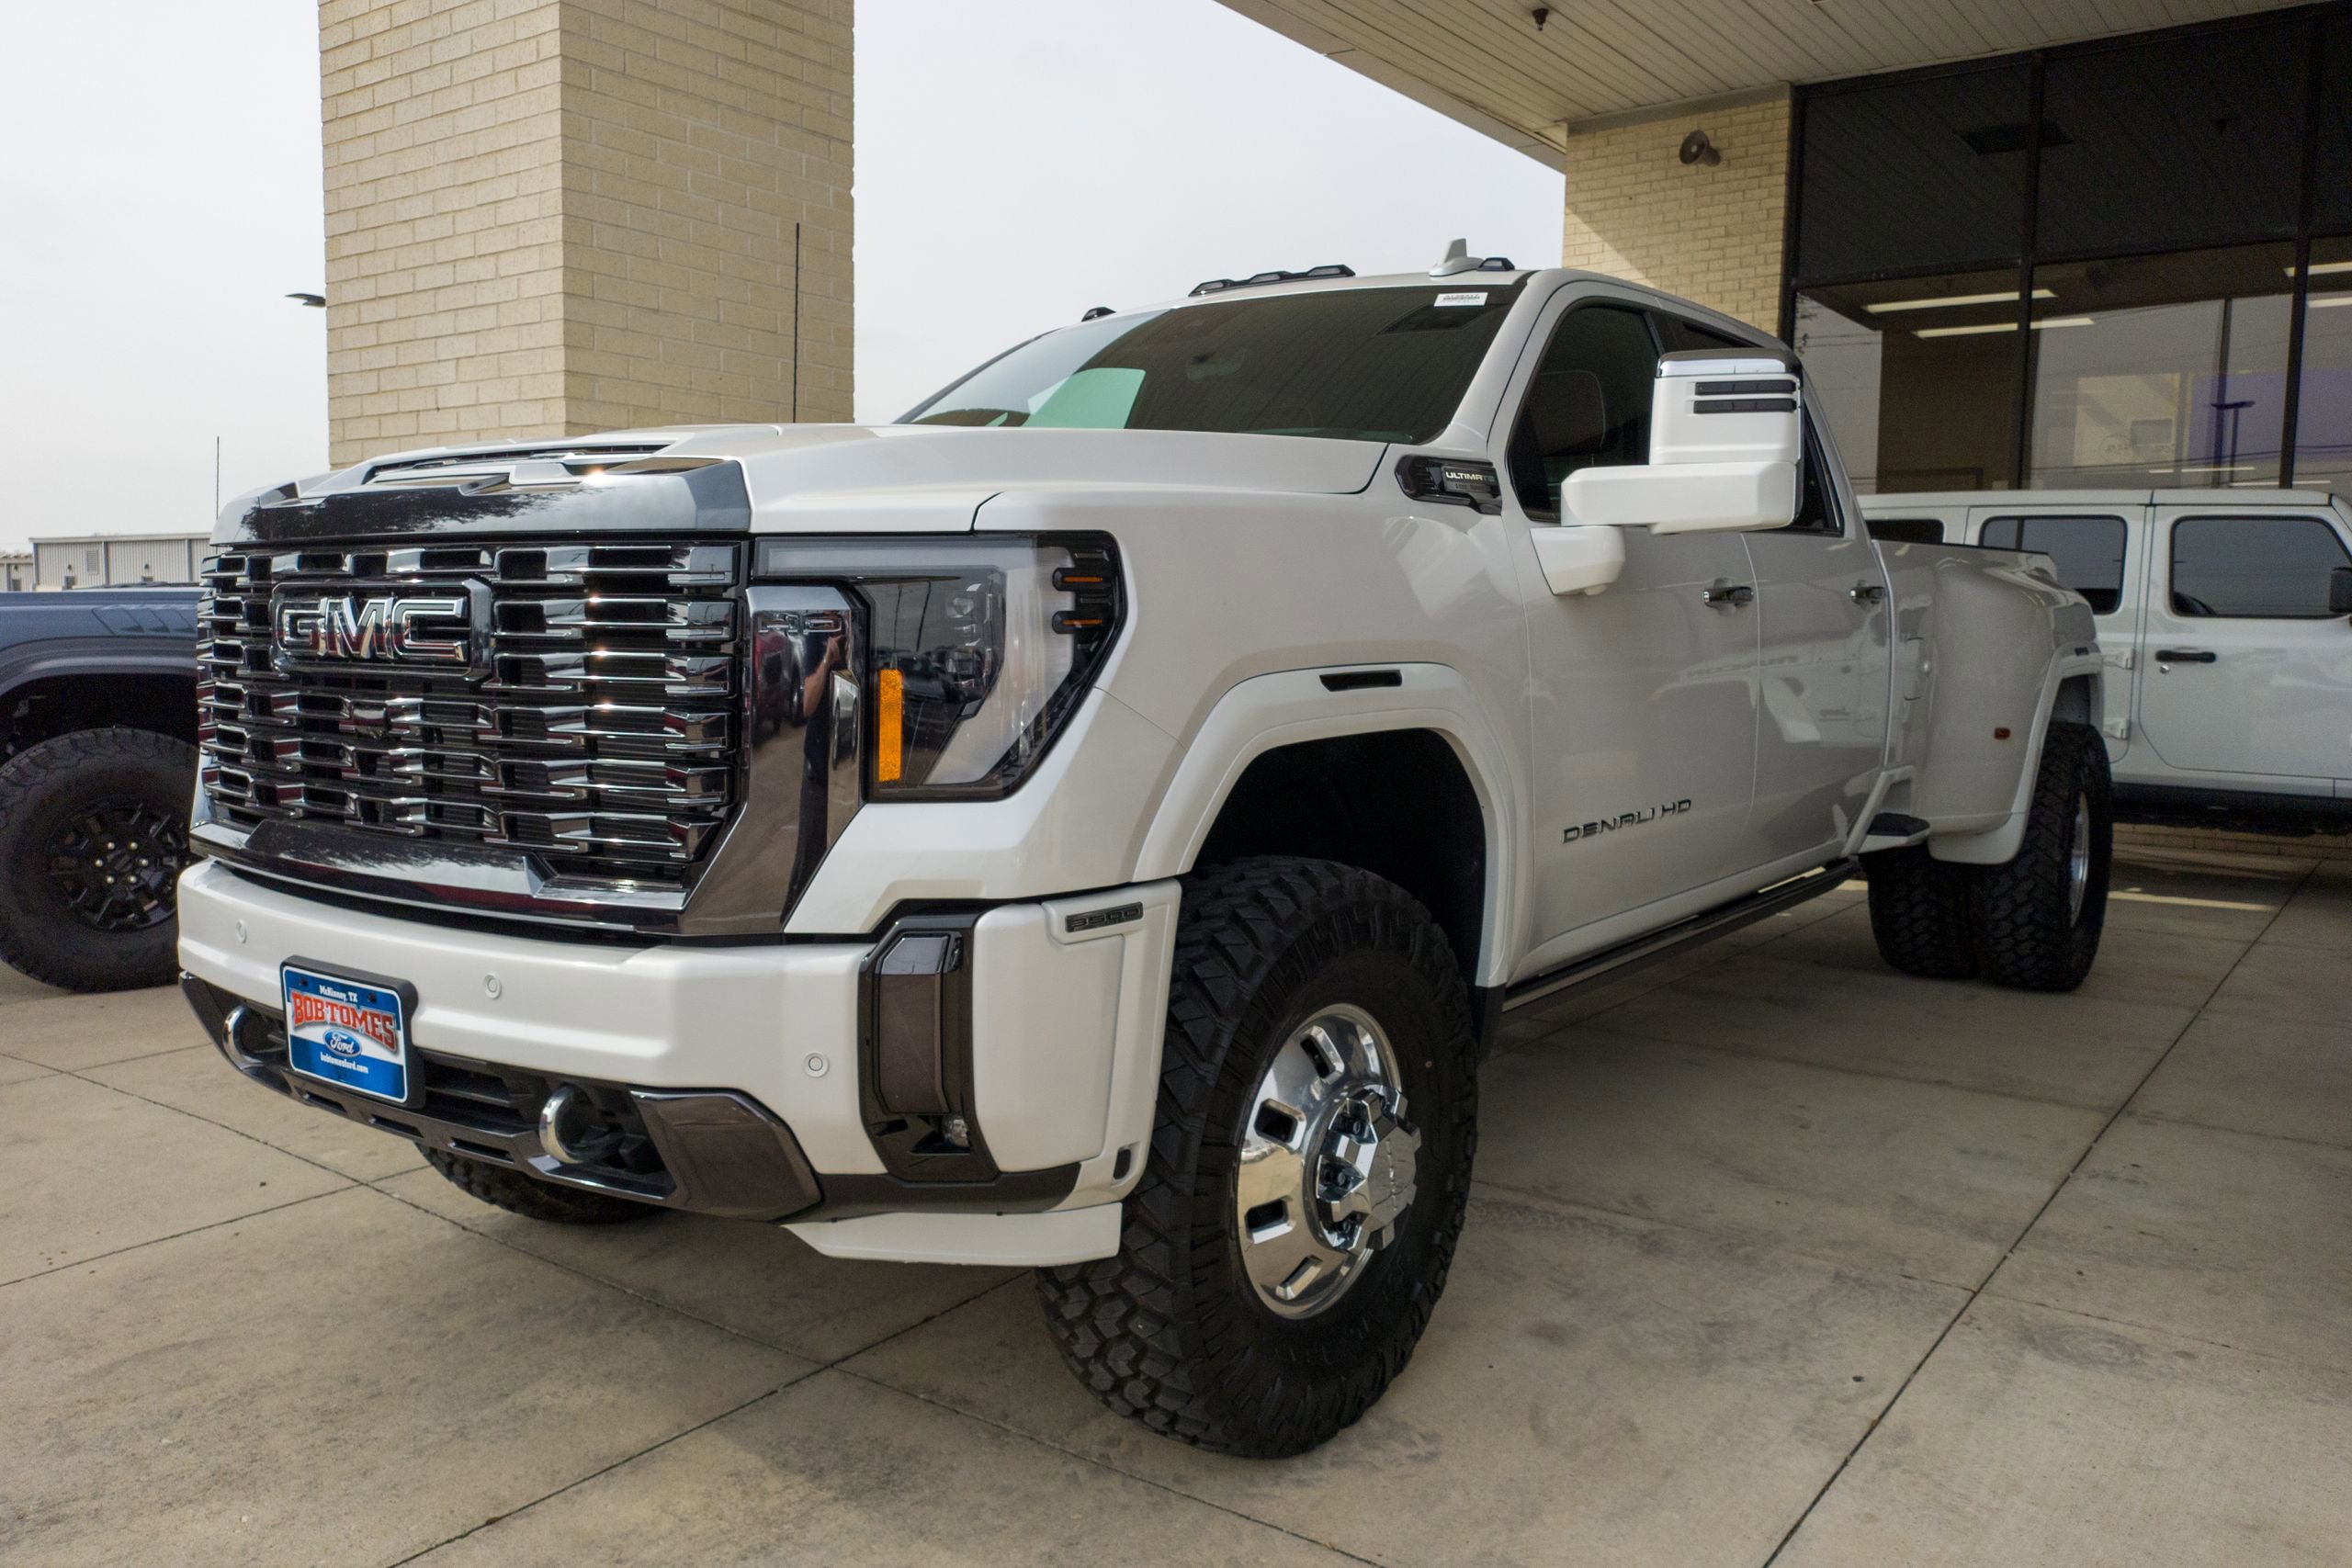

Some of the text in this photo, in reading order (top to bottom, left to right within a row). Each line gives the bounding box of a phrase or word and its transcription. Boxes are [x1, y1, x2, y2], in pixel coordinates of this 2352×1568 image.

[276, 597, 467, 661] GMC
[1563, 798, 1691, 843] DENALI HD
[348, 991, 358, 1003] TX
[330, 1031, 355, 1054] Ford
